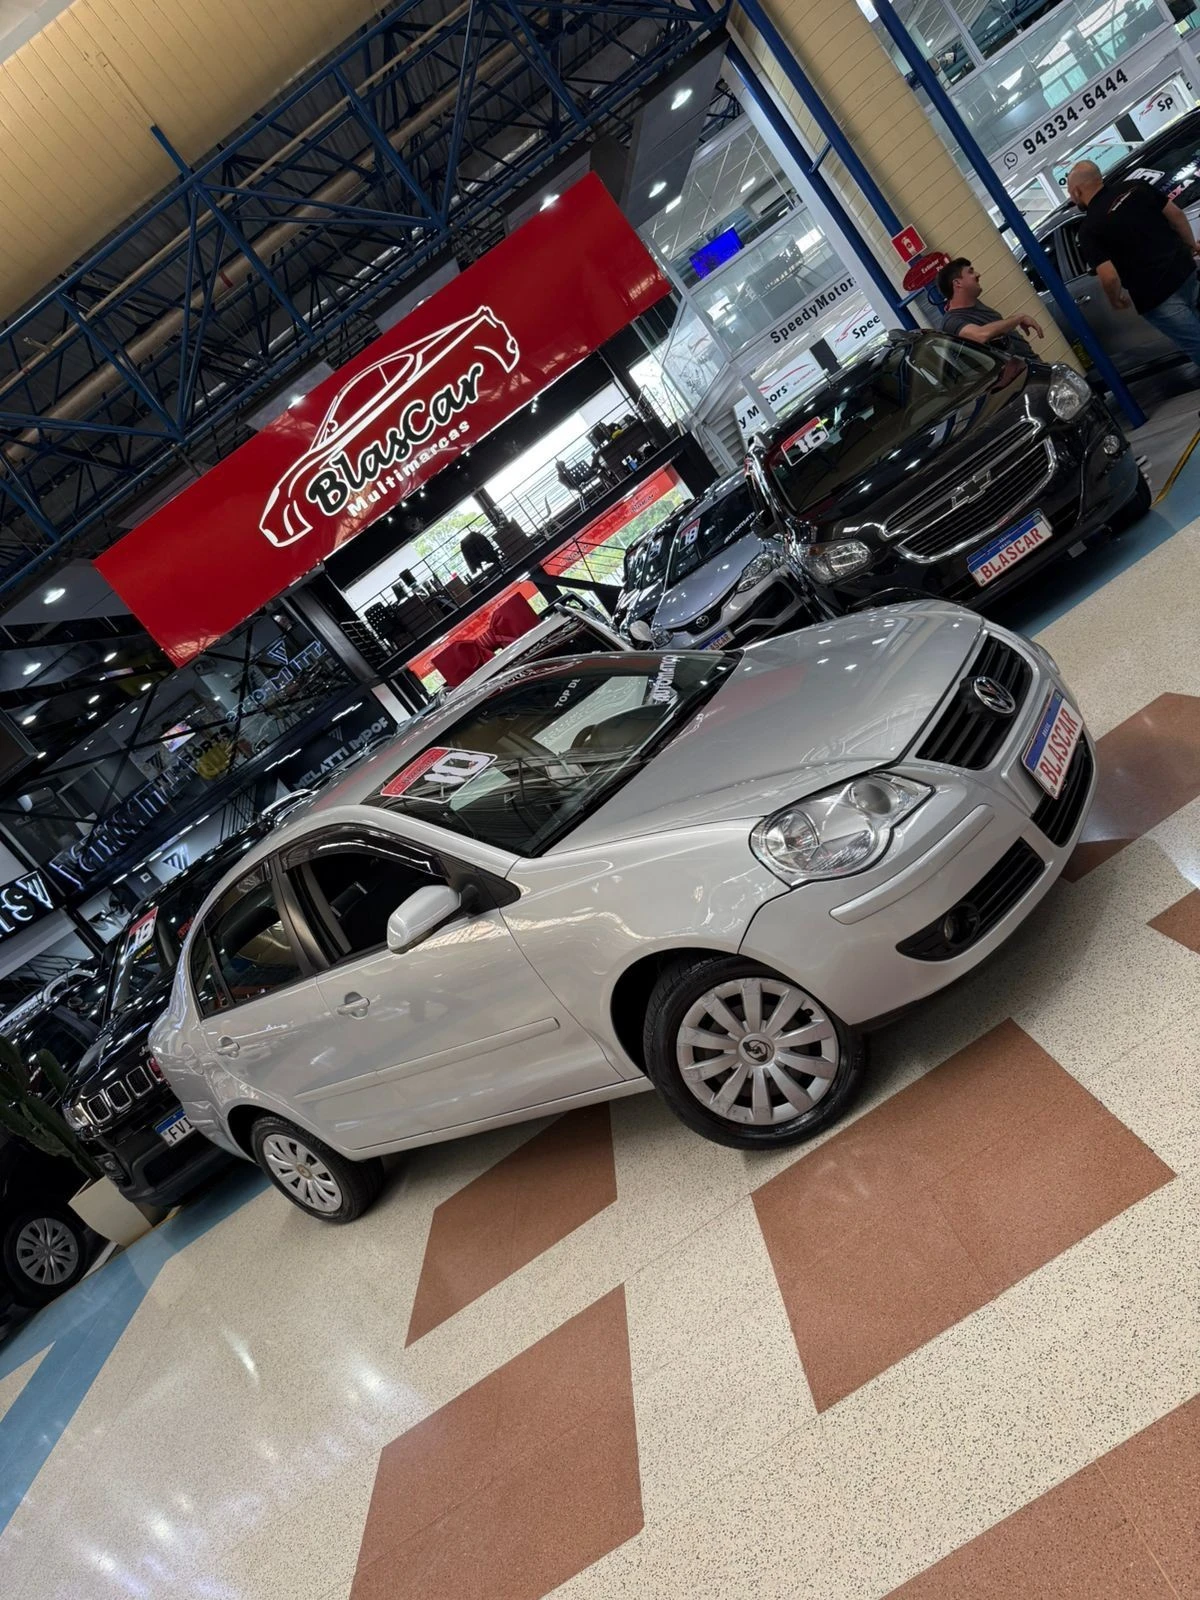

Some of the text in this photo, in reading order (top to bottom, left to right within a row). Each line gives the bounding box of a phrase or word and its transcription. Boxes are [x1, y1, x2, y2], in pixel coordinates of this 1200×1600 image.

[1022, 68, 1129, 155] 94334-6444
[306, 362, 484, 517] BlasCar
[346, 420, 470, 517] Multimarcas
[795, 428, 827, 453] 16
[980, 527, 1043, 580] BLASCAR
[554, 689, 570, 708] TOP
[424, 751, 491, 785] 10
[1040, 707, 1078, 786] BLASCAR
